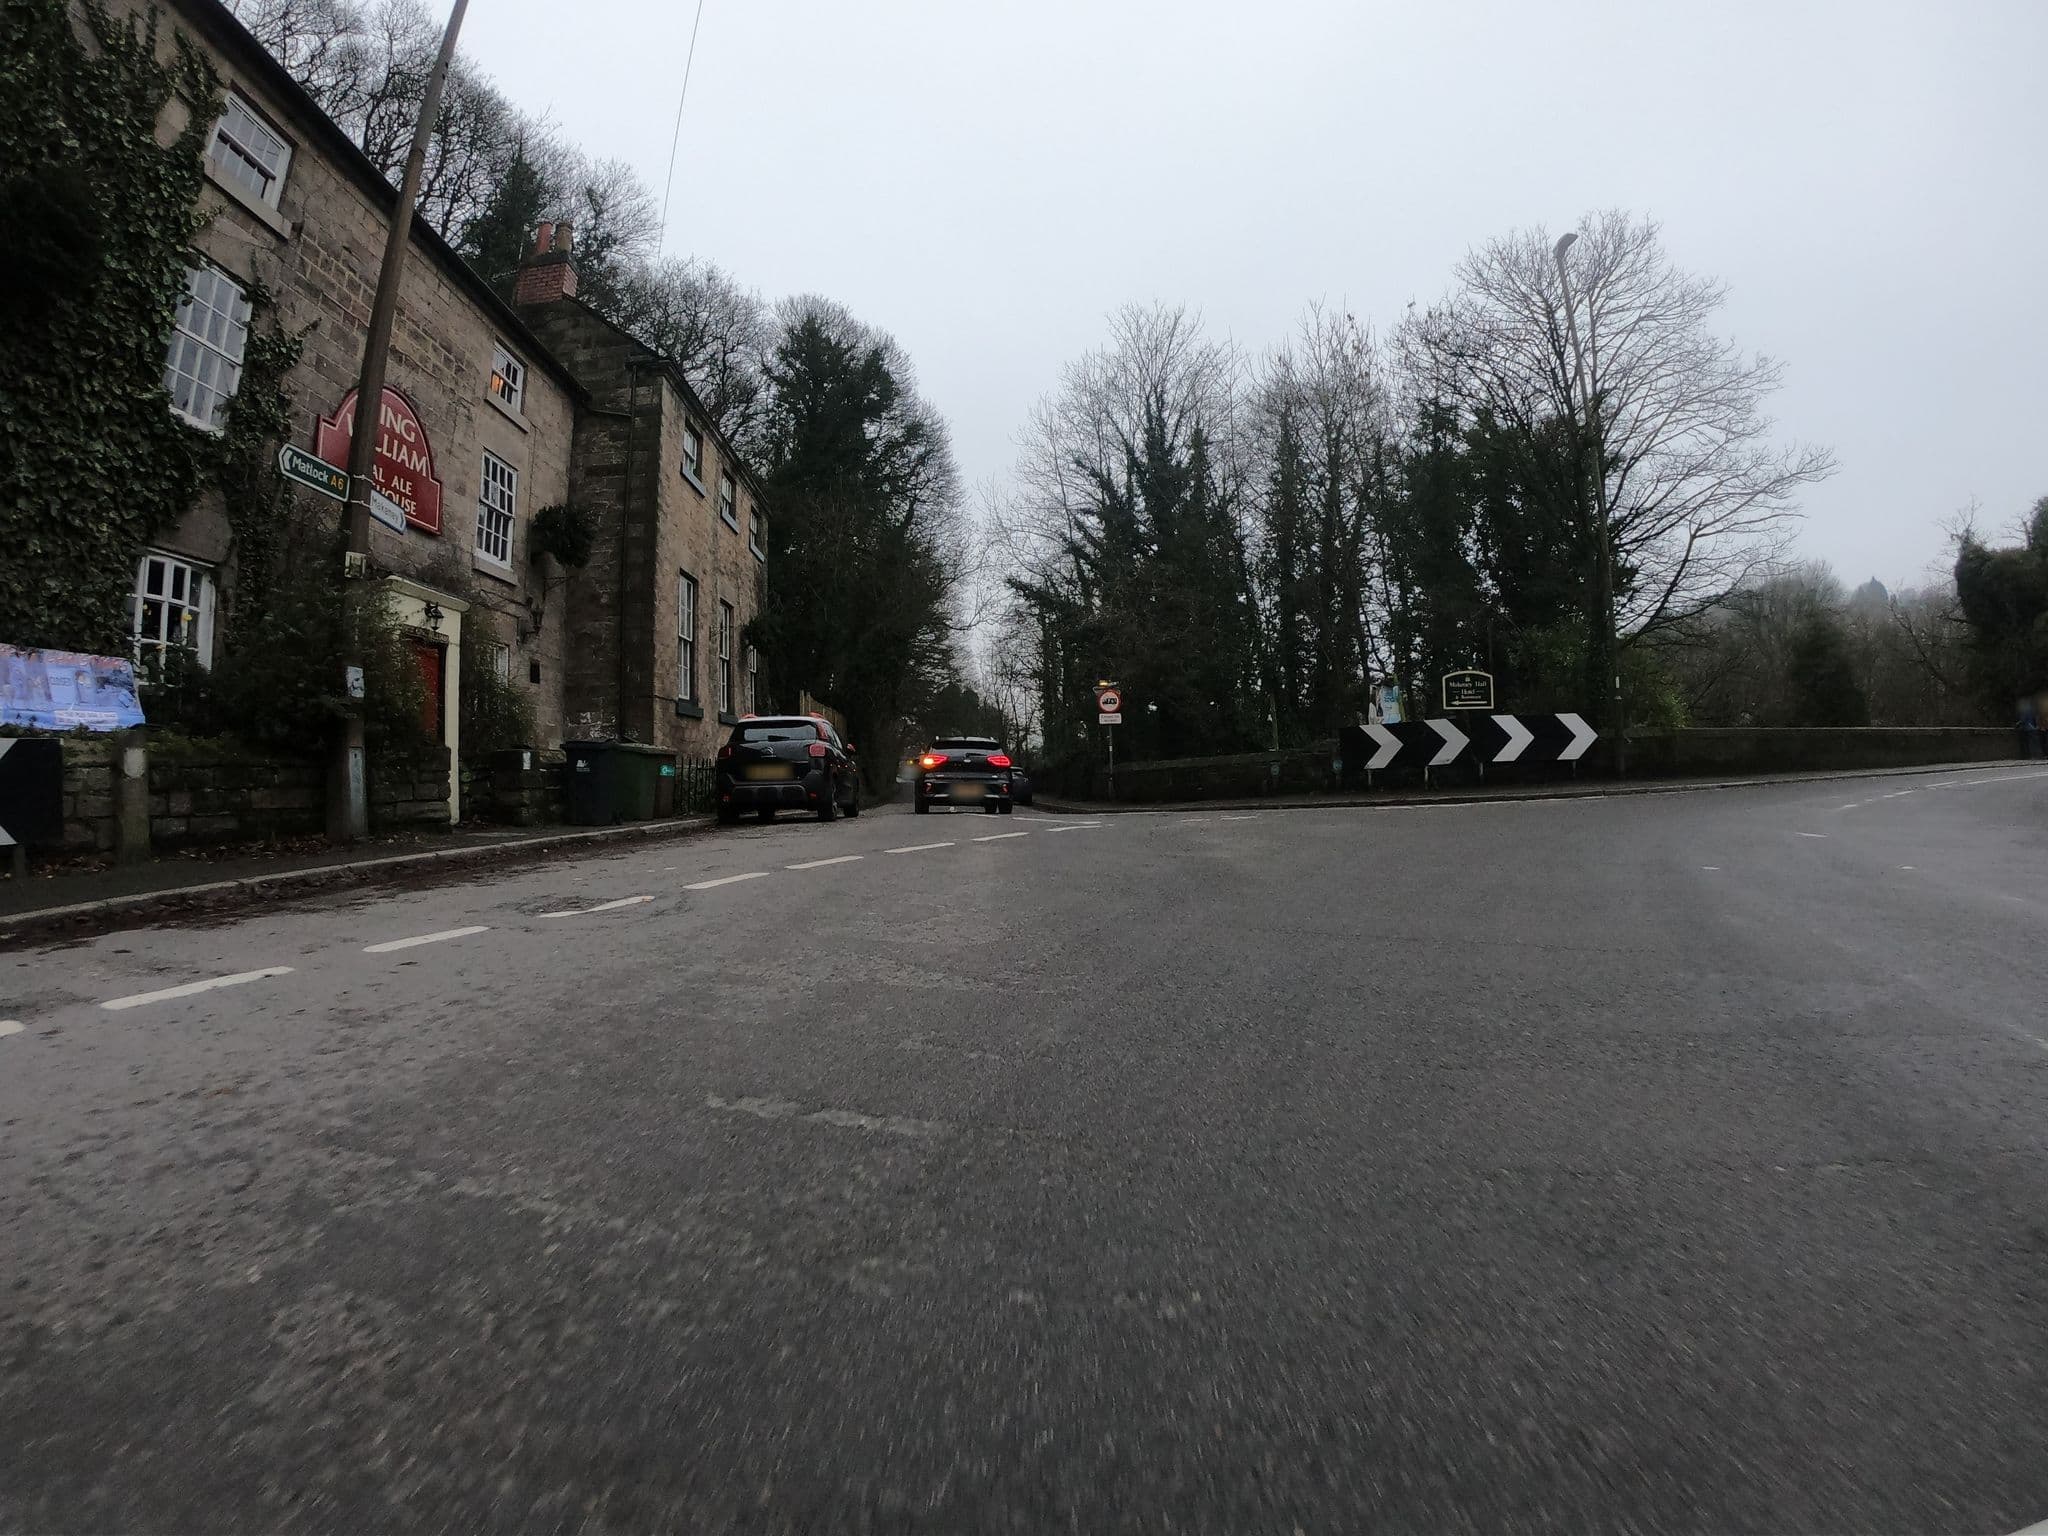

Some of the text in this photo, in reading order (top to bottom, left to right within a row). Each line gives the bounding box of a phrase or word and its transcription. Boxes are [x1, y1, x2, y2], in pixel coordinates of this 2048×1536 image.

[379, 403, 416, 443] ING
[292, 455, 344, 490] Matlock A6
[391, 475, 412, 496] ALE
